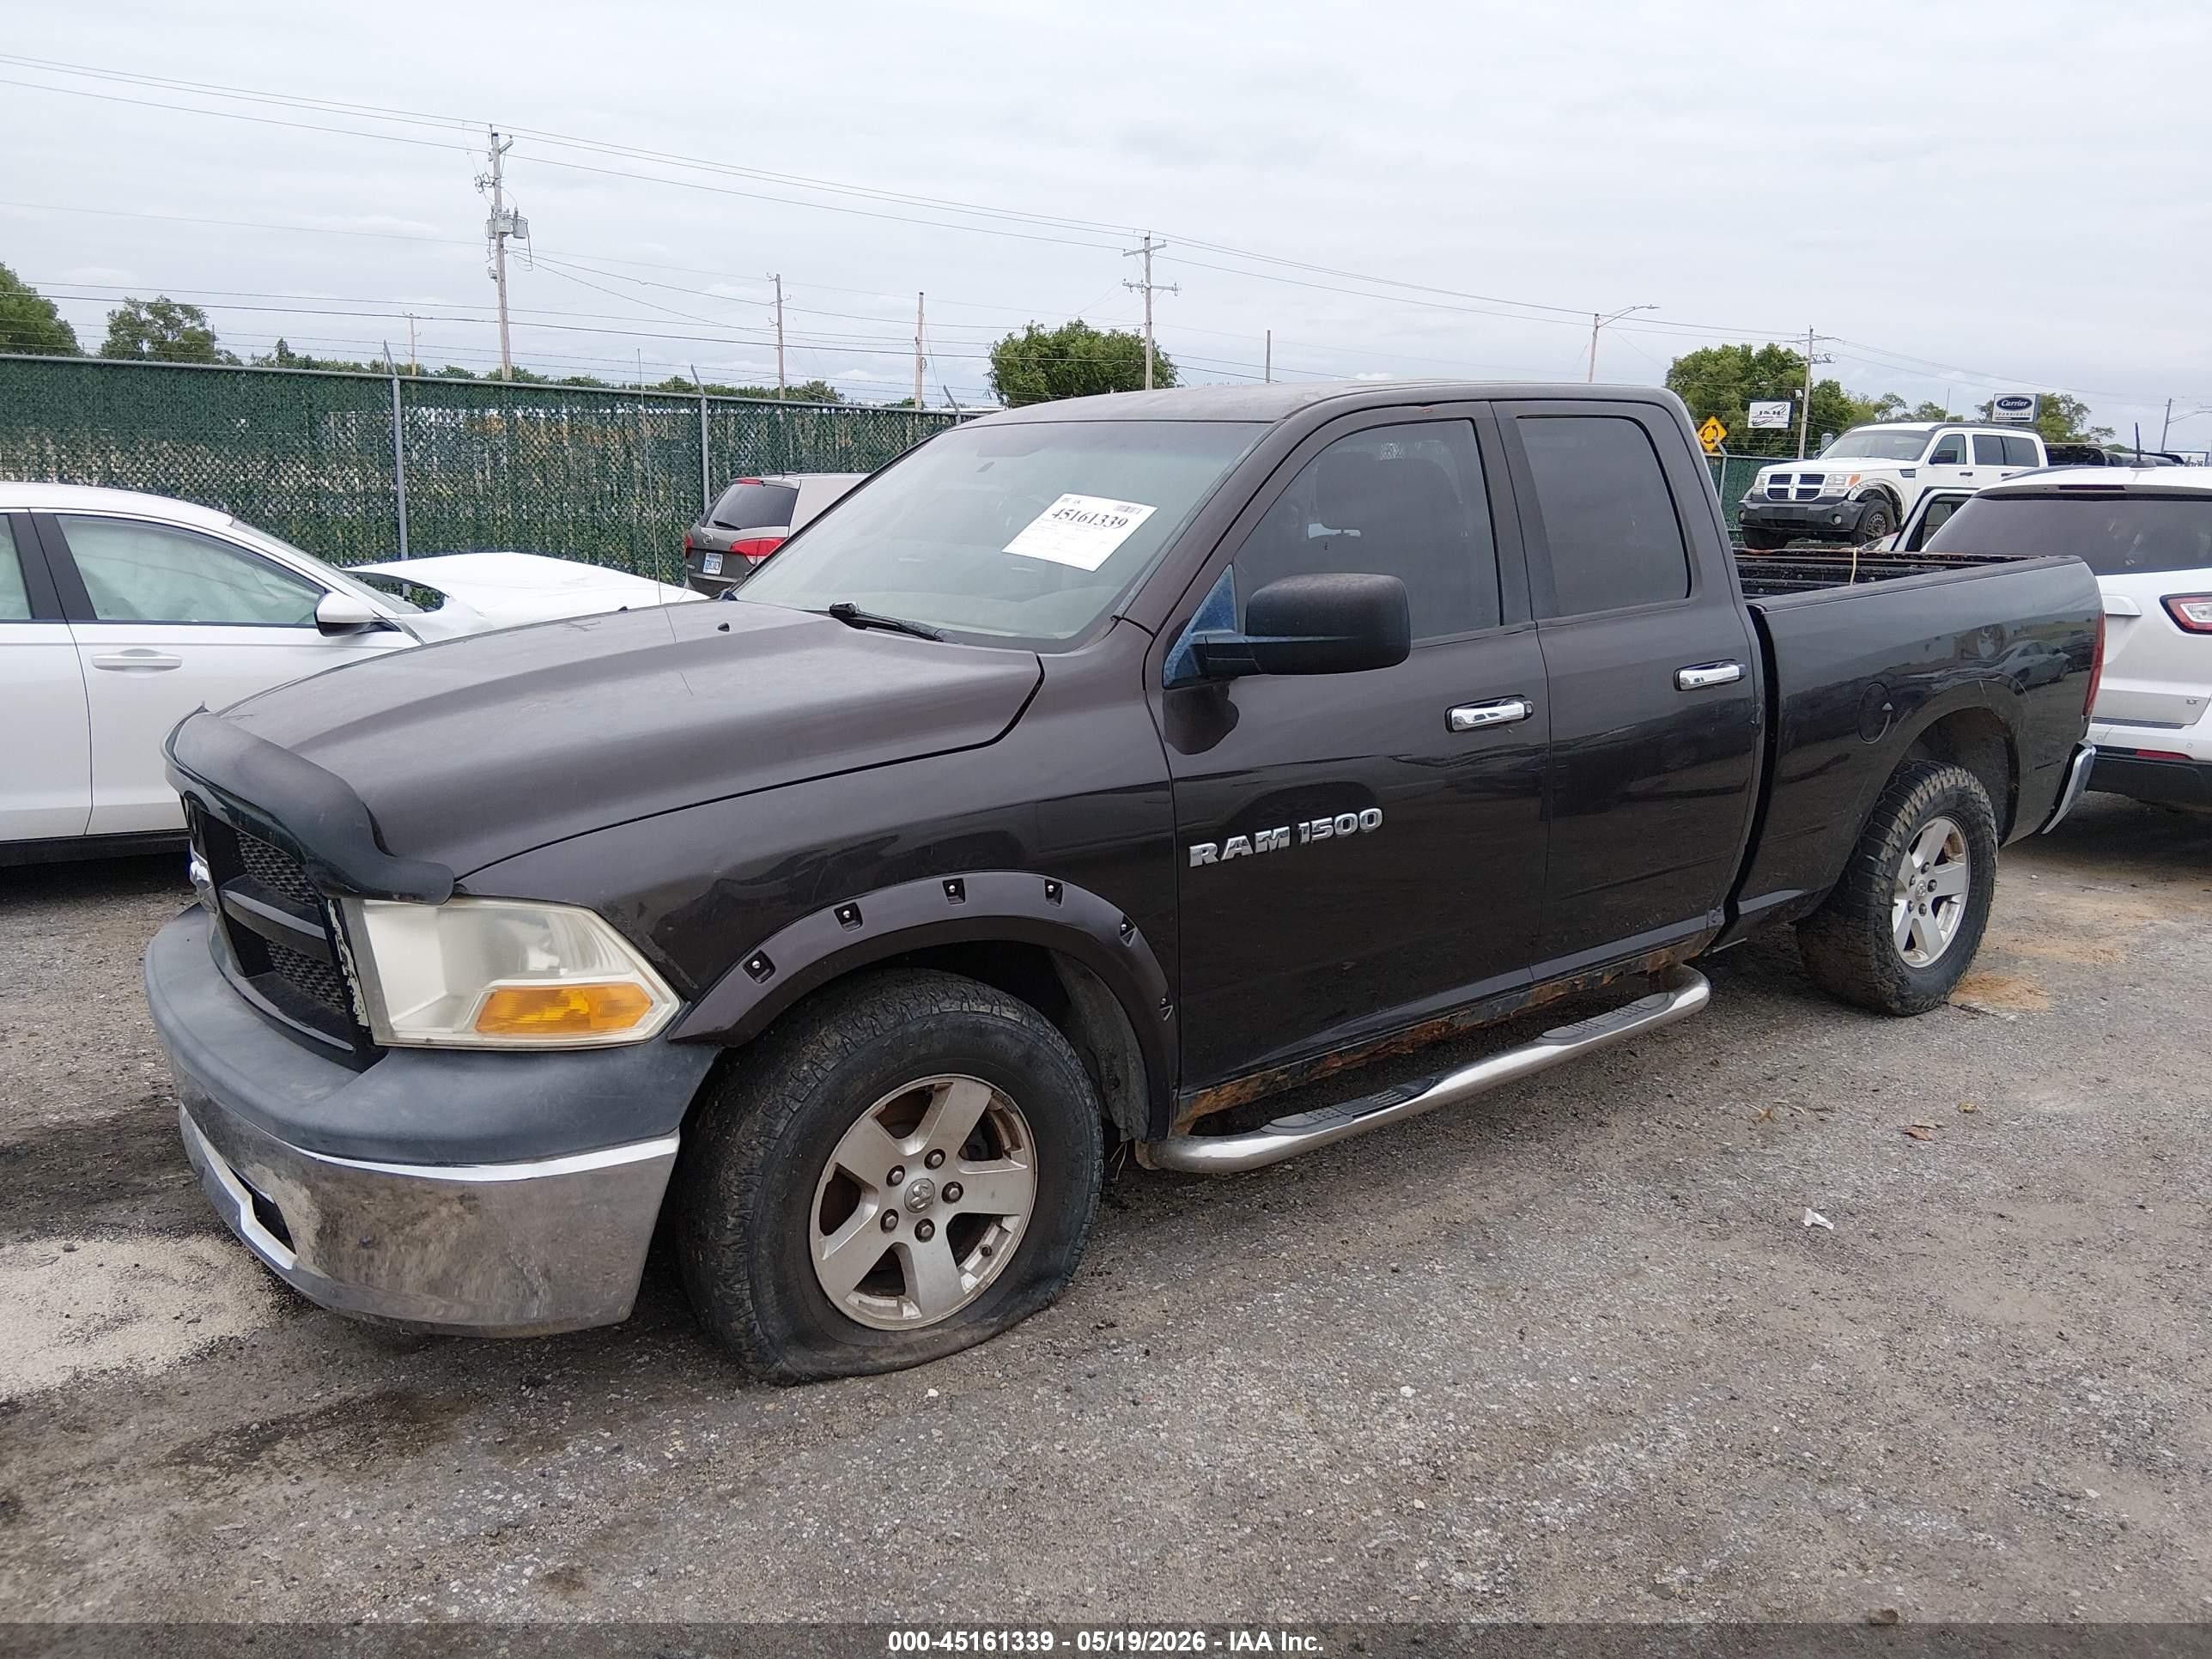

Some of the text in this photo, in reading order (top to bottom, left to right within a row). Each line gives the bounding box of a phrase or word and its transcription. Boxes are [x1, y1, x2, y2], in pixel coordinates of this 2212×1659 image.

[1051, 507, 1129, 529] 45161339
[1189, 807, 1383, 867] RAM 1500
